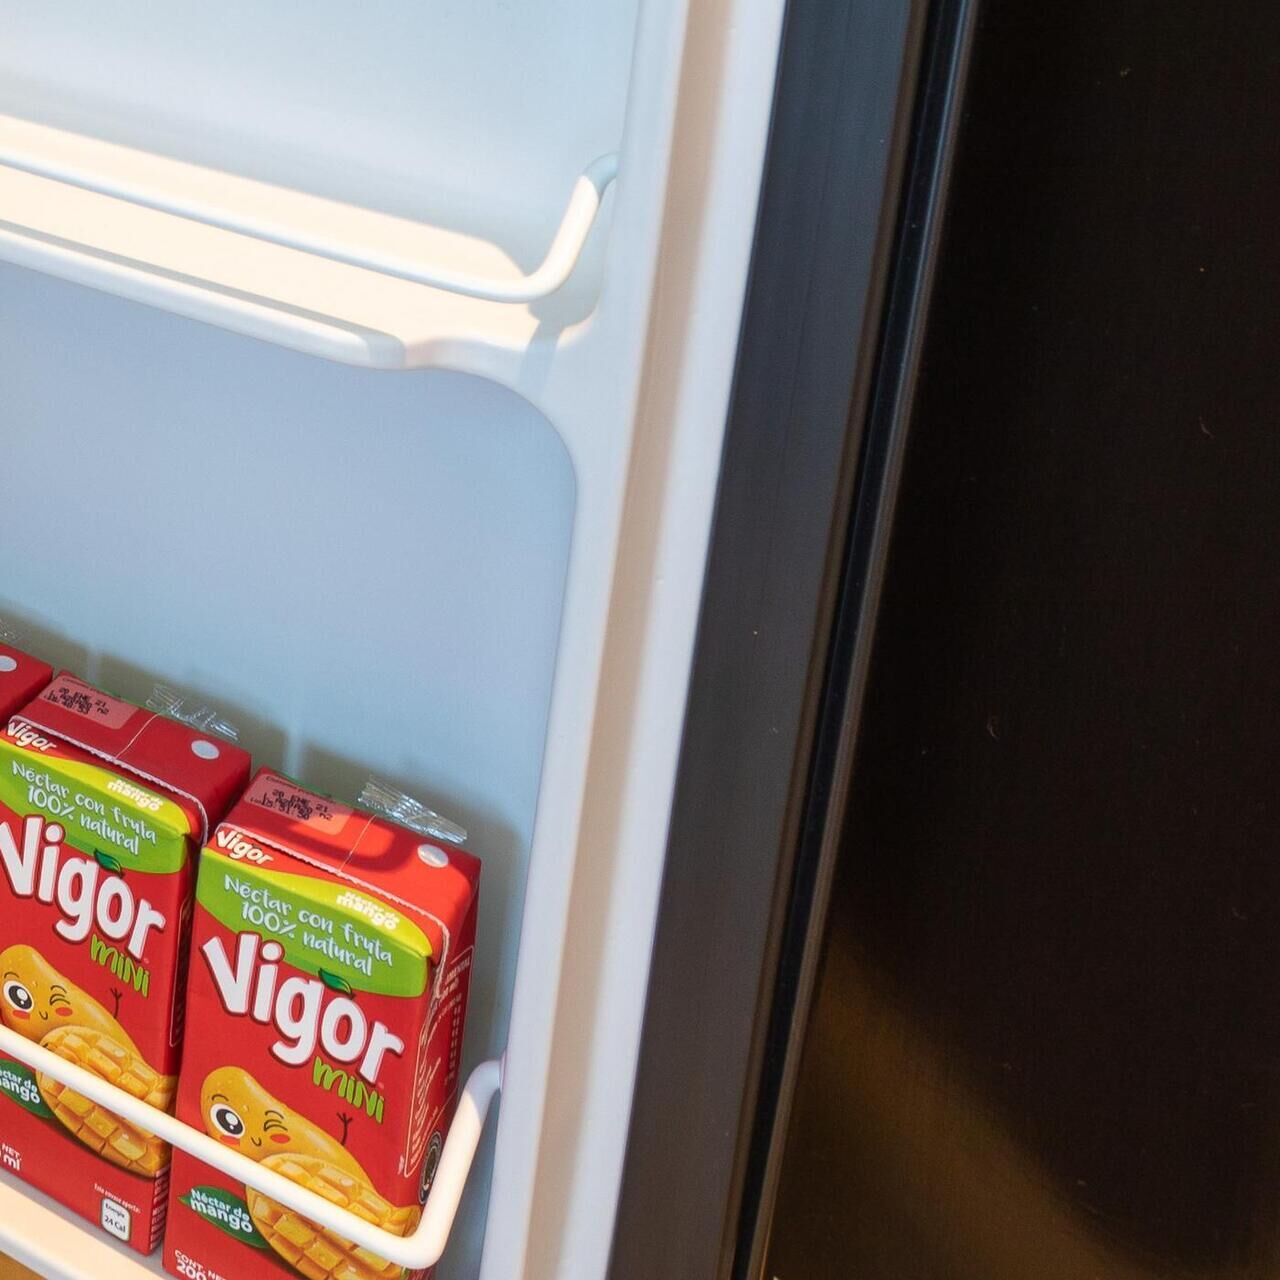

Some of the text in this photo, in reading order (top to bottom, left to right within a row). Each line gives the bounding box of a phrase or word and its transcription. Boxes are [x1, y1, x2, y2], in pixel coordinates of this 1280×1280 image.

[7, 721, 57, 752] Vigor
[12, 760, 158, 846] Néctar con fruta
[27, 785, 139, 856] 100% natural
[216, 829, 274, 865] Vigor
[224, 874, 394, 967] Néctar con fruta
[240, 901, 373, 977] 100% natural
[202, 933, 406, 1085] Vigor
[23, 1078, 38, 1093] de
[3, 1153, 22, 1171] ml
[190, 1187, 251, 1221] Néctar de
[190, 1197, 253, 1233] mango
[113, 1221, 126, 1233] Cal
[174, 1249, 206, 1275] CONT.
